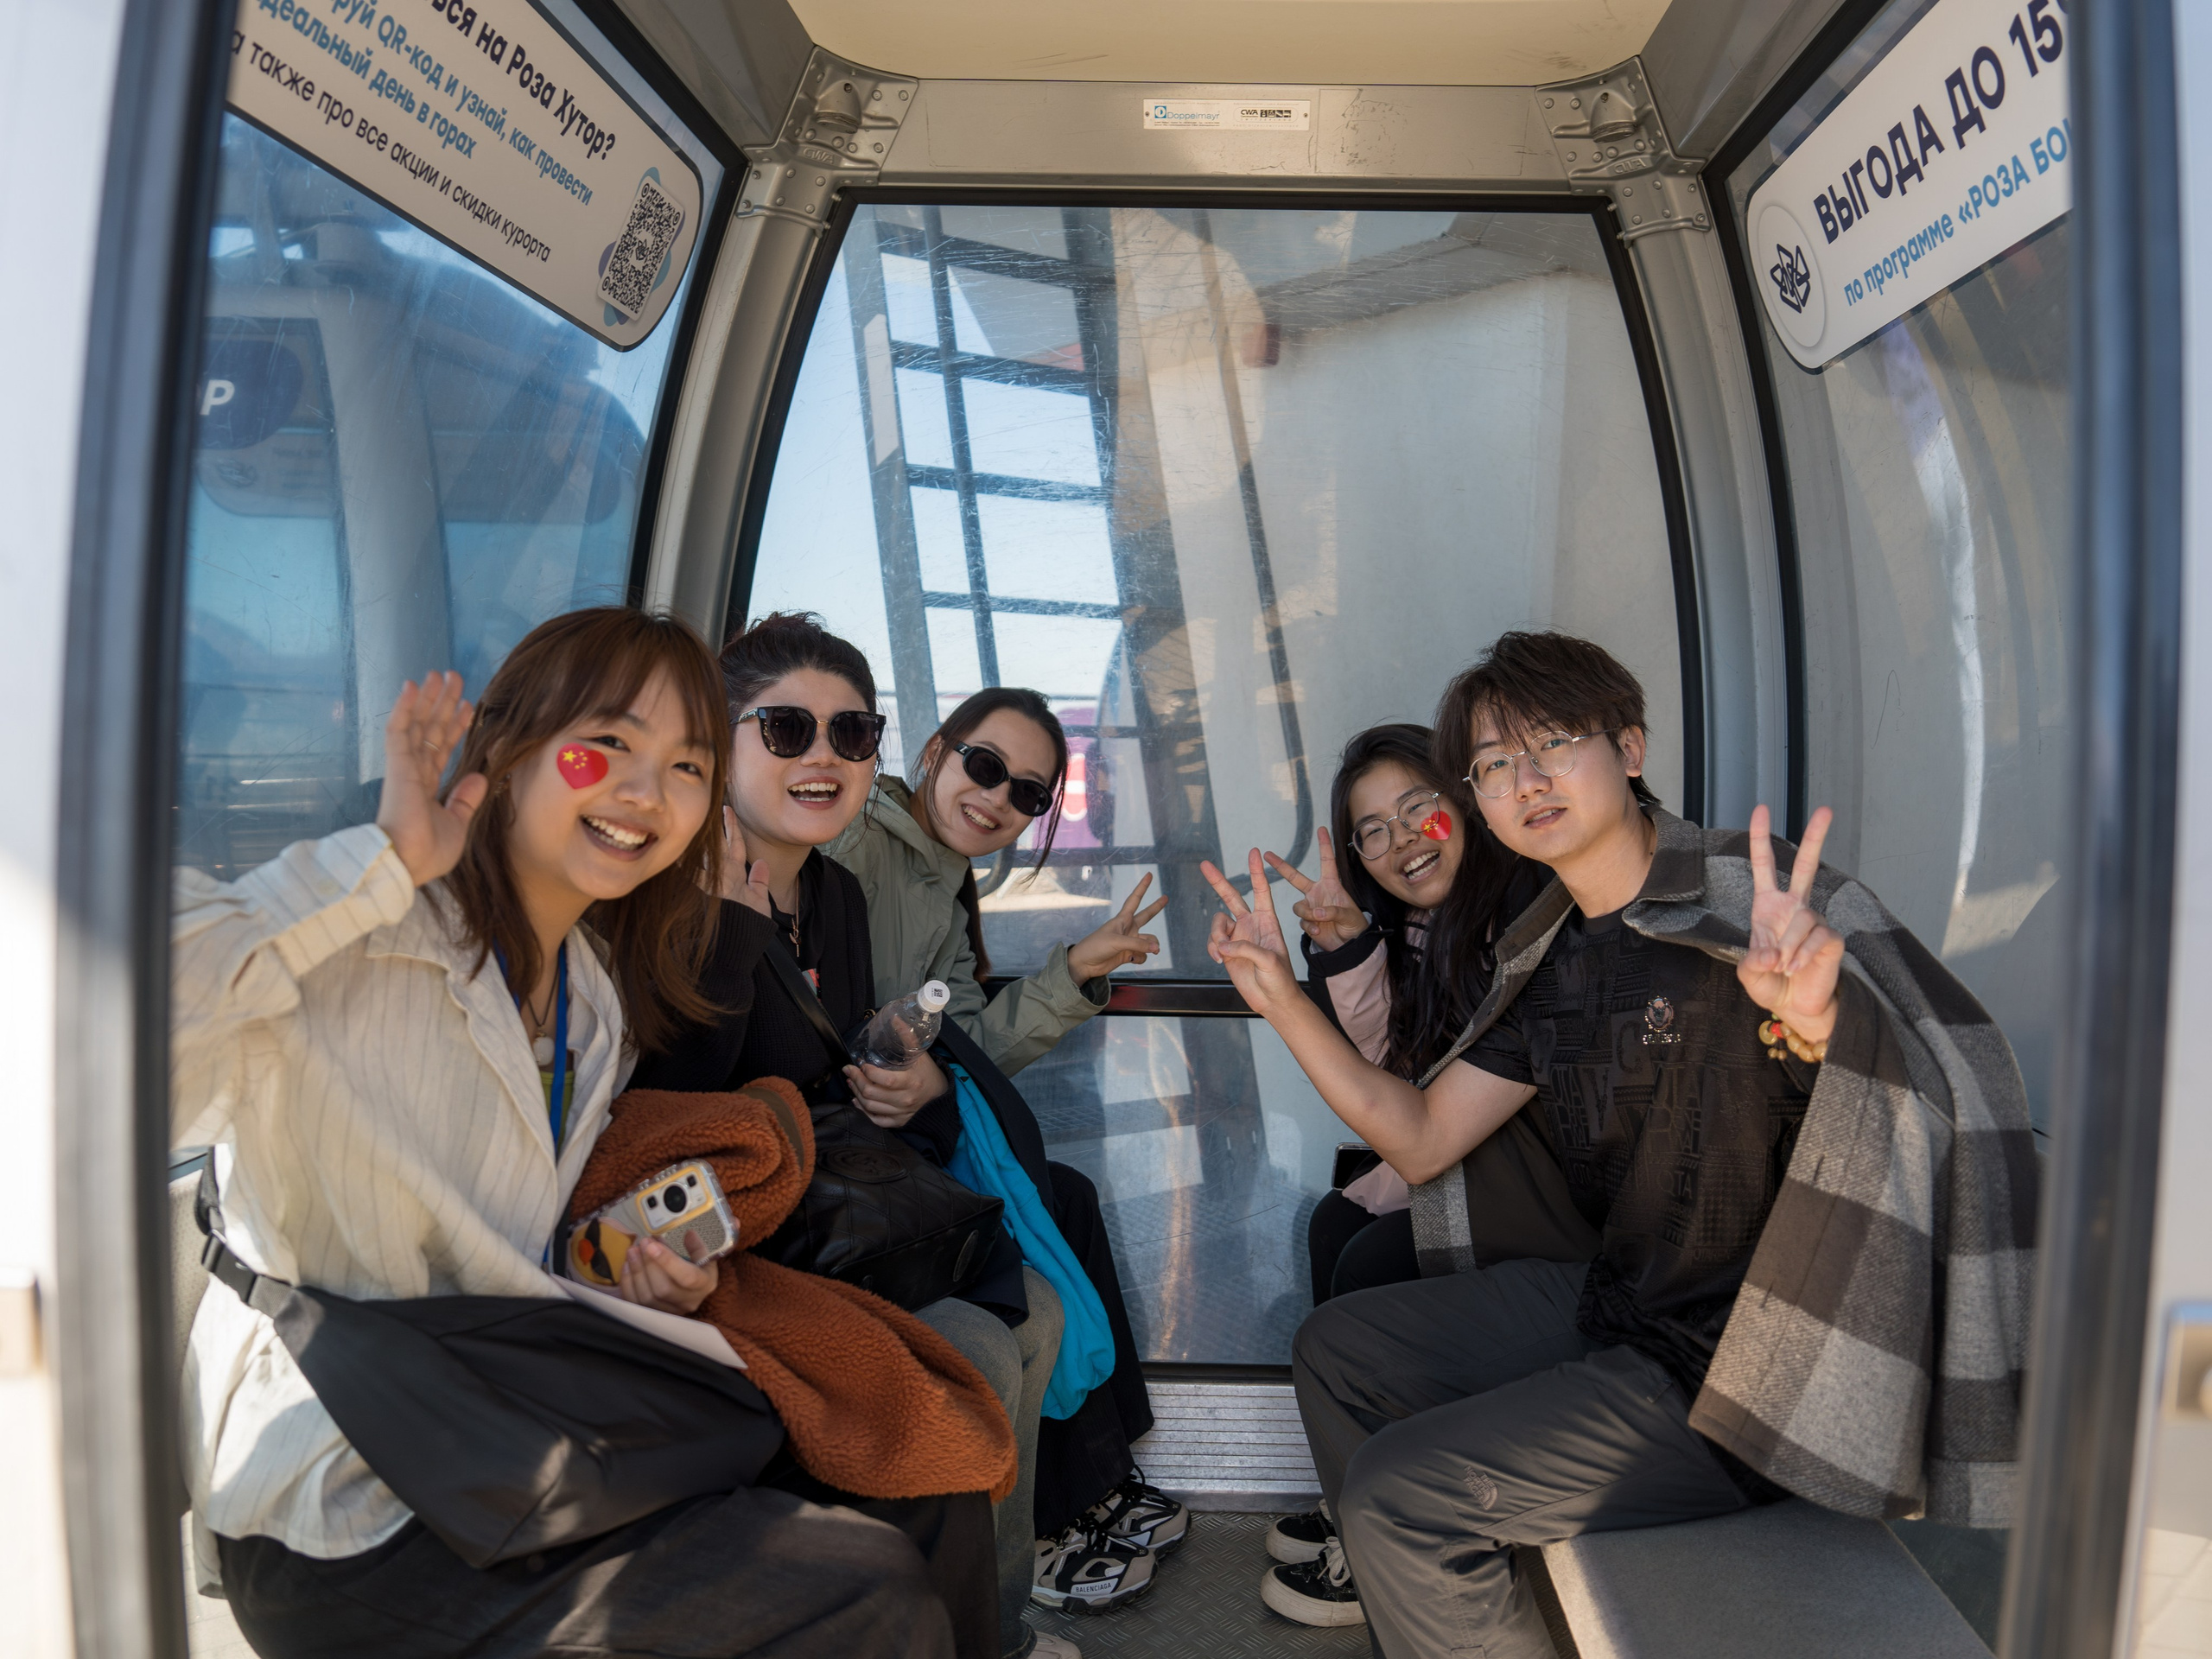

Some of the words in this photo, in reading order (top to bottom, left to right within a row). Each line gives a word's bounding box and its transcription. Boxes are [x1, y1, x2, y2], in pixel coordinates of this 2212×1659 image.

[232, 29, 245, 54] а
[250, 41, 315, 101] также
[316, 91, 354, 128] про
[355, 118, 388, 151] все
[391, 143, 440, 188] акции
[439, 175, 452, 195] и
[452, 185, 502, 230] скидки
[501, 218, 551, 263] курорта
[368, 68, 416, 114] день
[416, 101, 430, 124] в
[429, 111, 477, 159] горах
[378, 15, 444, 91] QR-код
[443, 74, 459, 98] и
[455, 85, 508, 142] узнай,
[509, 128, 537, 161] как
[535, 149, 594, 206] провести
[475, 21, 508, 66] на
[505, 43, 556, 110] Роза
[553, 87, 616, 161] Хутор?
[1166, 111, 1220, 121] Doppelmayr
[1813, 104, 1946, 245] ВЫГОДА
[1944, 46, 2005, 150] ДО
[2008, 0, 2069, 78] 15
[1844, 278, 1864, 307] по
[1863, 213, 1955, 296] программе
[1958, 155, 2031, 224] «РОЗА
[1076, 1582, 1112, 1592] BALENCIAGA
